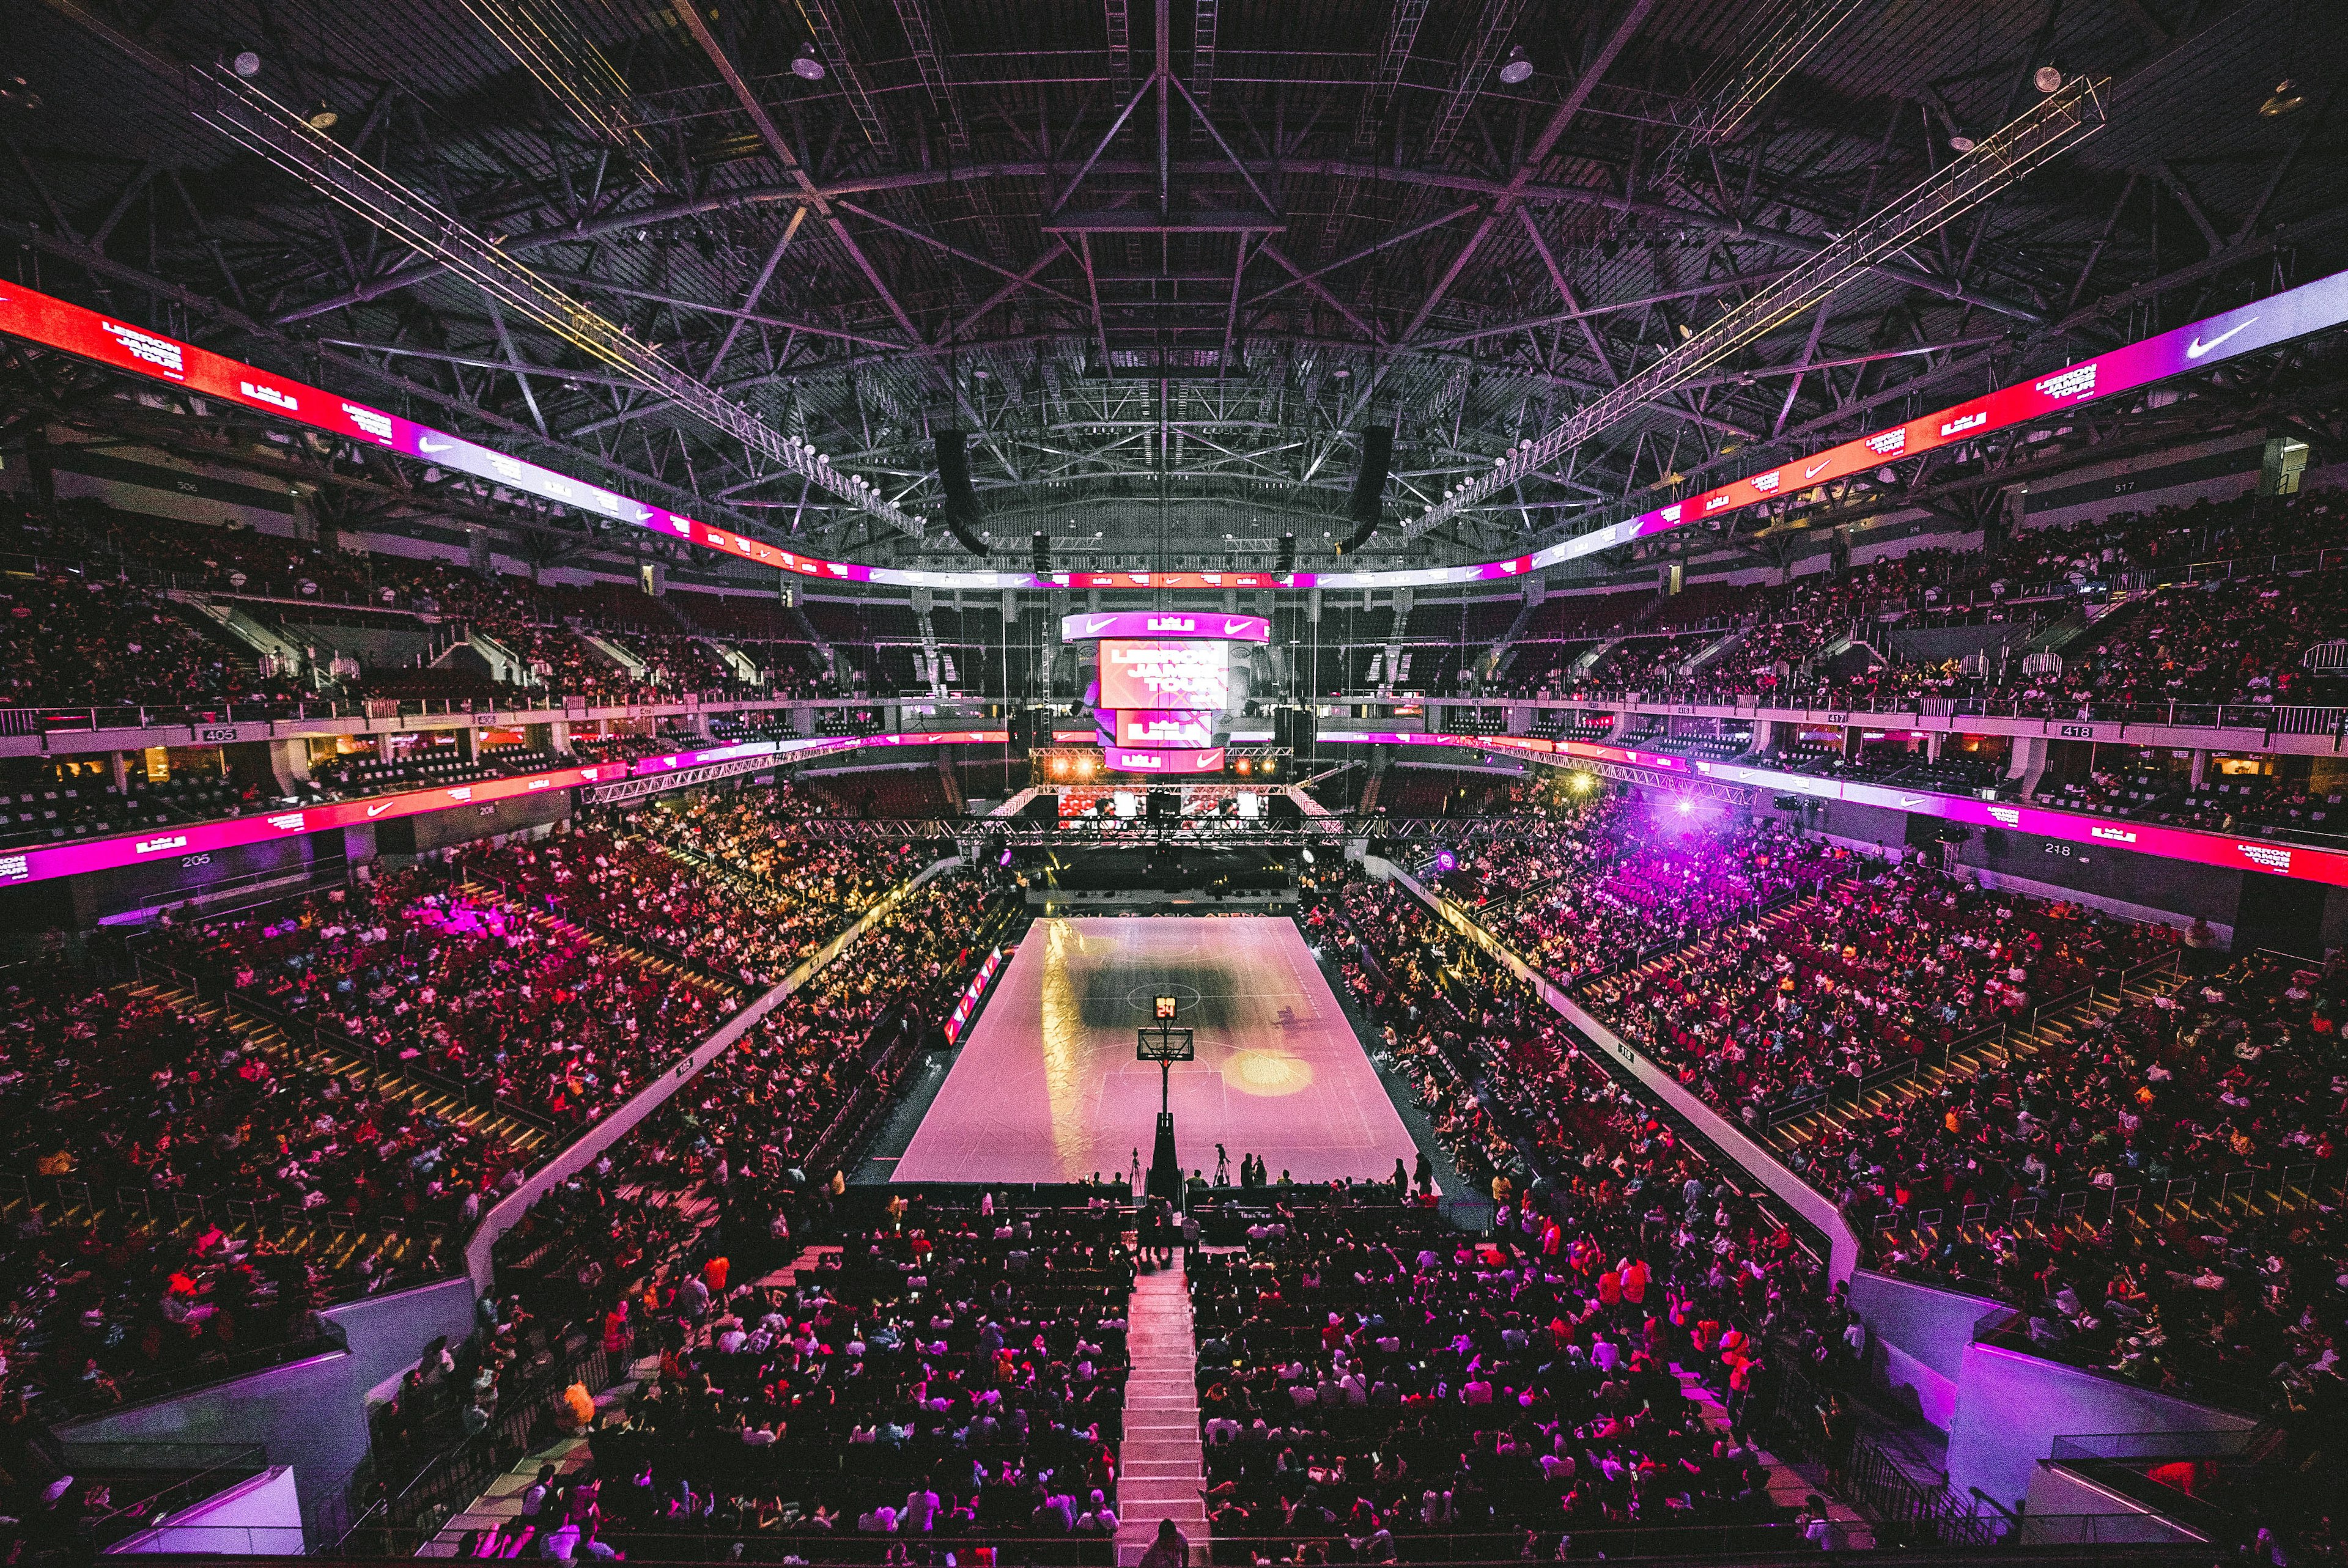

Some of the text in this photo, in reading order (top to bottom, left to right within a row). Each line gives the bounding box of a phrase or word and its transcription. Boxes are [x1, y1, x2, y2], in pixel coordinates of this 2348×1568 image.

[102, 321, 182, 355] LEBRON
[129, 347, 183, 371] TOUR
[2036, 363, 2097, 391] LEBRON
[2044, 372, 2096, 395] JAMES
[2052, 380, 2095, 399] TOUR
[1877, 440, 1905, 454] TOUR
[2115, 482, 2135, 493] 517
[1112, 649, 1220, 664] LEBRON
[1127, 663, 1220, 678] JAMES
[1144, 677, 1220, 692] TOUR
[207, 730, 234, 740] 405
[2064, 727, 2090, 737] 418
[2045, 843, 2070, 856] 218
[2238, 844, 2292, 858] LEBRON
[182, 853, 210, 867] 205
[2245, 852, 2291, 863] JAMES
[2252, 856, 2290, 868] TOUR
[1157, 1006, 1174, 1018] 24
[1622, 1046, 1631, 1060] 118
